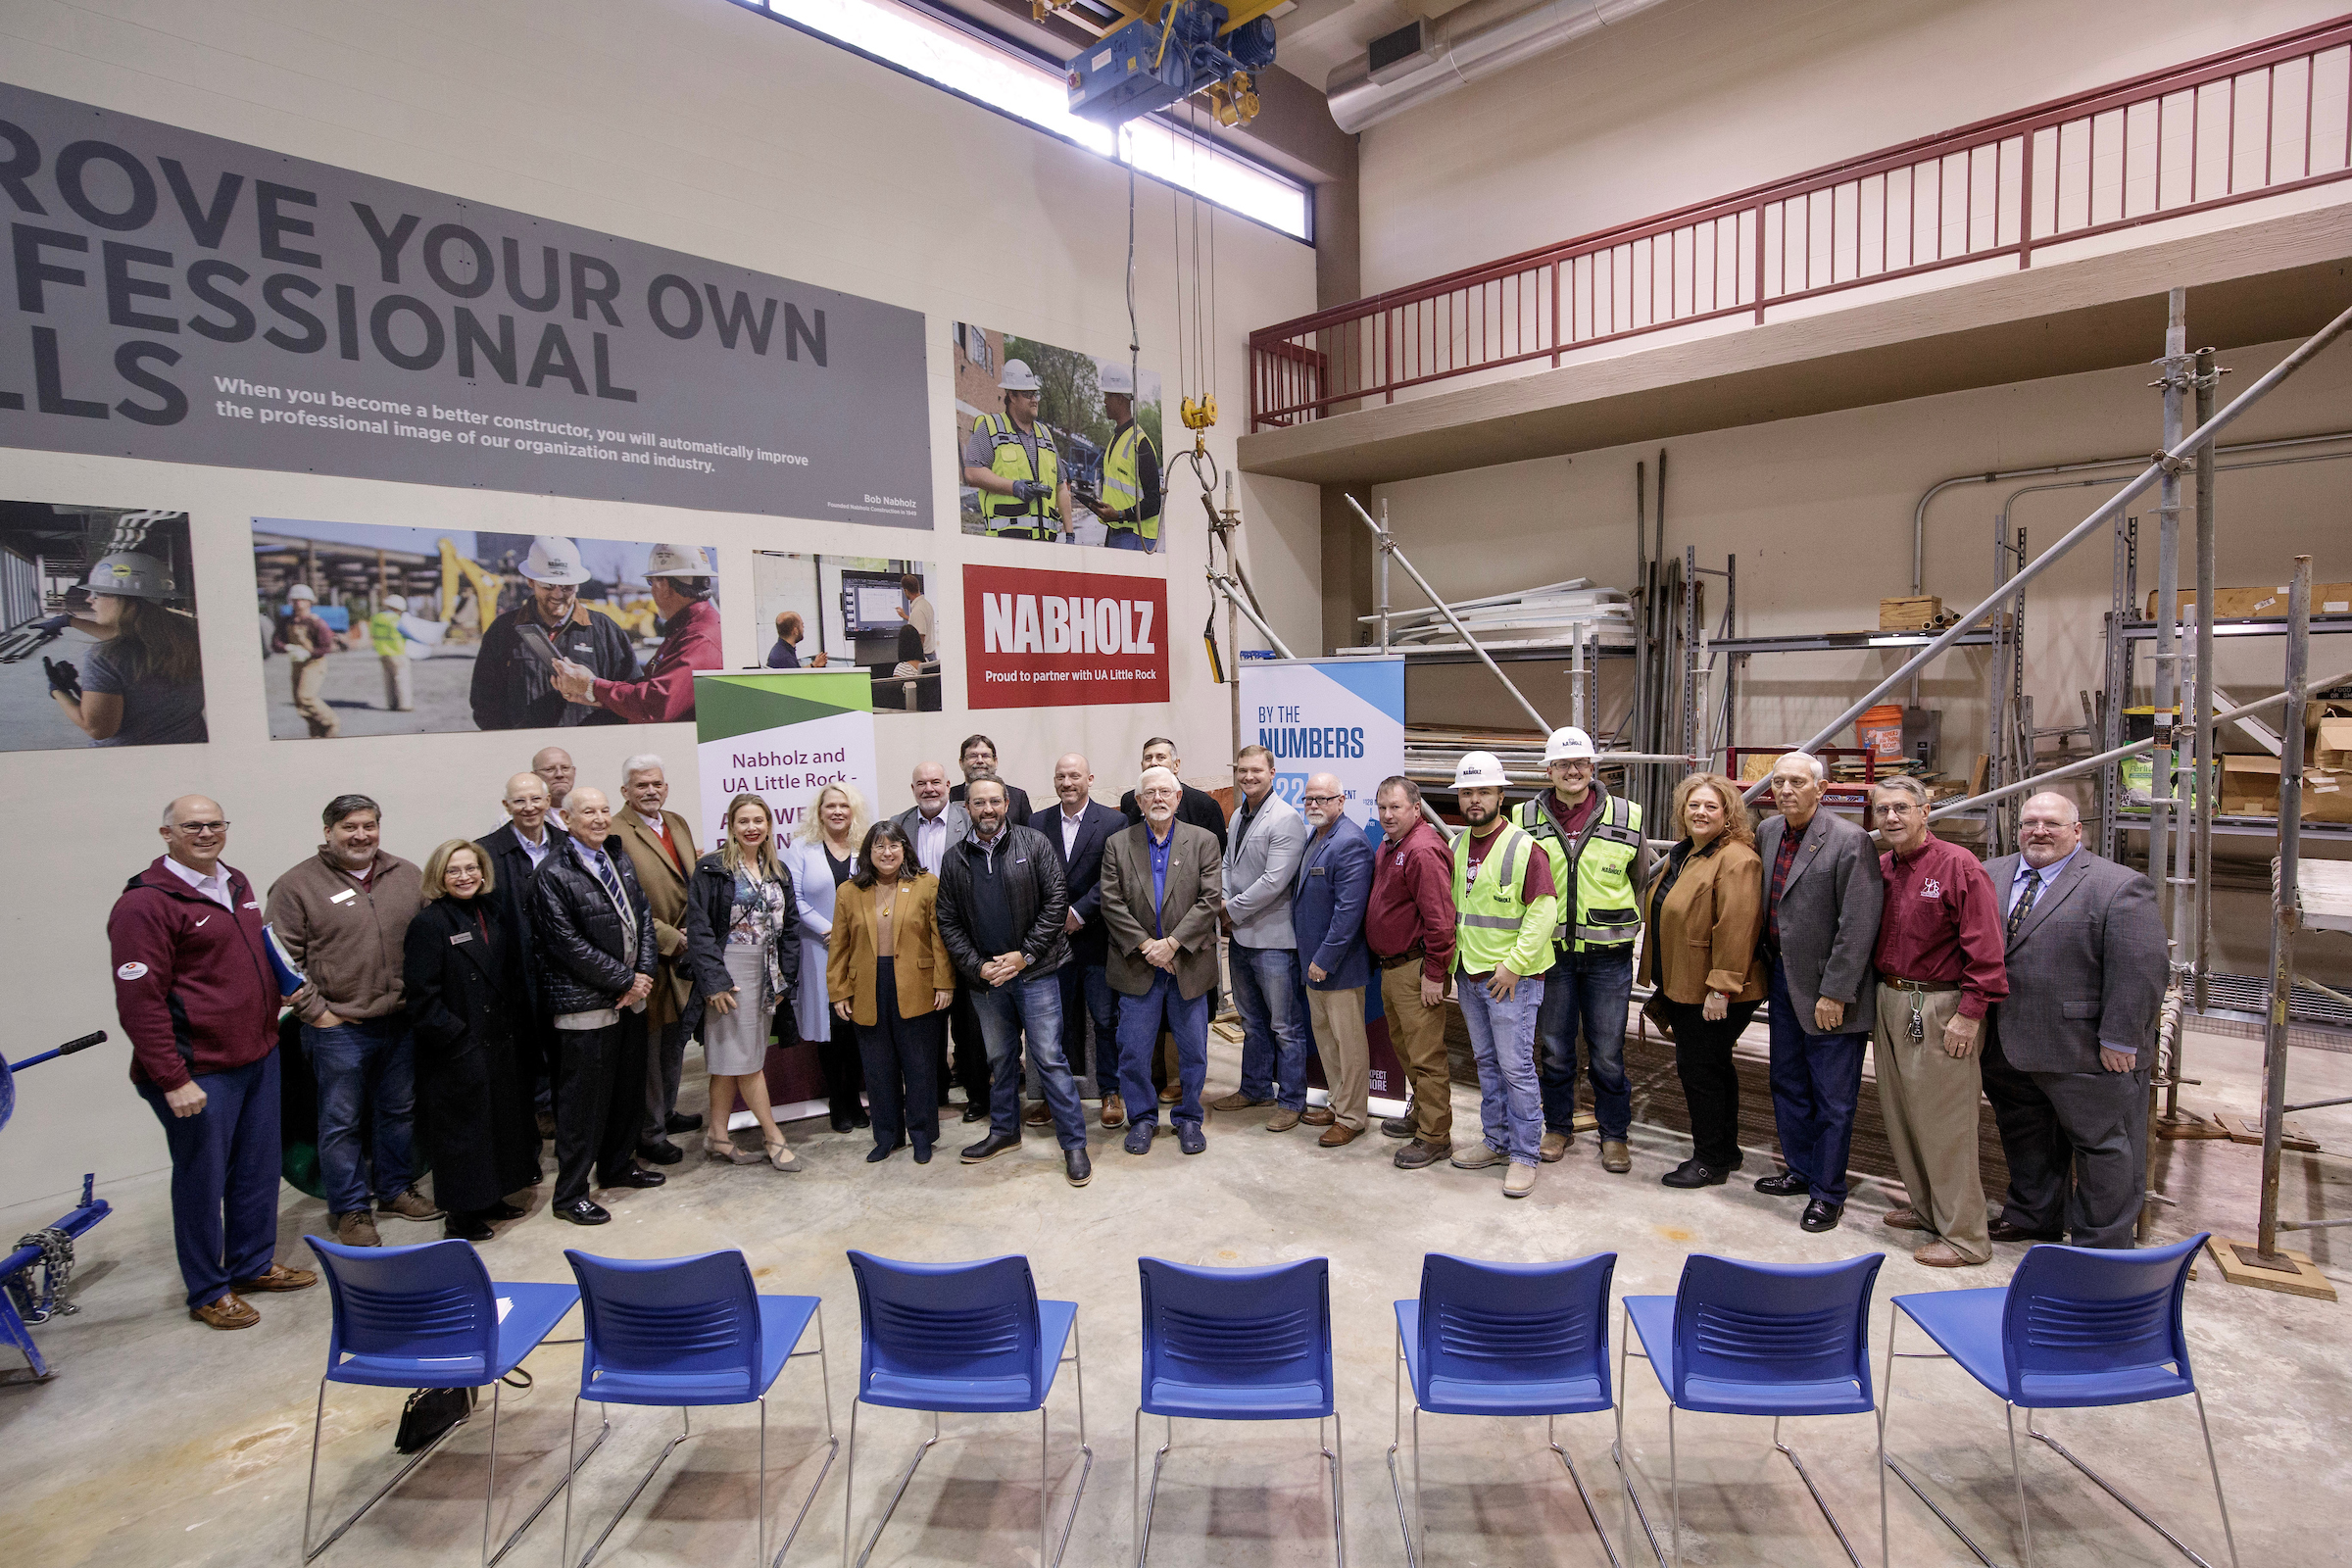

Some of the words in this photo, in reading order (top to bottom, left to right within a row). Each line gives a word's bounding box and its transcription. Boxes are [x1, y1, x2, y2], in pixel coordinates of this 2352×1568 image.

[349, 201, 624, 327] YOUR
[648, 274, 826, 367] OWN
[10, 221, 637, 402] FESSIONAL
[214, 375, 280, 399] When
[287, 388, 326, 404] you
[331, 391, 411, 416] become
[416, 406, 427, 417] a
[432, 405, 488, 424] better
[493, 415, 593, 441] constructor,
[597, 429, 625, 442] you
[629, 432, 656, 447] will
[660, 437, 754, 461] automatically
[758, 448, 808, 466] improve
[216, 400, 254, 418] the
[261, 408, 389, 434] professional
[394, 421, 452, 443] image
[458, 431, 476, 445] of
[481, 435, 510, 448] our
[514, 439, 617, 462] organization
[622, 451, 650, 465] and
[654, 453, 714, 473] industry.
[864, 494, 881, 504] Bob
[883, 496, 916, 508] Nabholz
[870, 506, 900, 514] Construction
[983, 592, 1155, 655] NABHOLZ
[985, 670, 1018, 682] Proud
[1019, 671, 1030, 682] to
[1033, 670, 1069, 683] partner
[1072, 669, 1093, 681] with
[1095, 669, 1108, 680] UA
[1110, 669, 1134, 680] Little
[1135, 668, 1157, 680] Rock
[1258, 707, 1273, 723] BY
[1278, 706, 1300, 723] THE
[1259, 727, 1364, 759] NUMBERS
[733, 750, 808, 768] Nabholz
[812, 748, 845, 763] and
[723, 777, 749, 793] UA
[755, 774, 801, 791] Little
[806, 770, 848, 787] Rock
